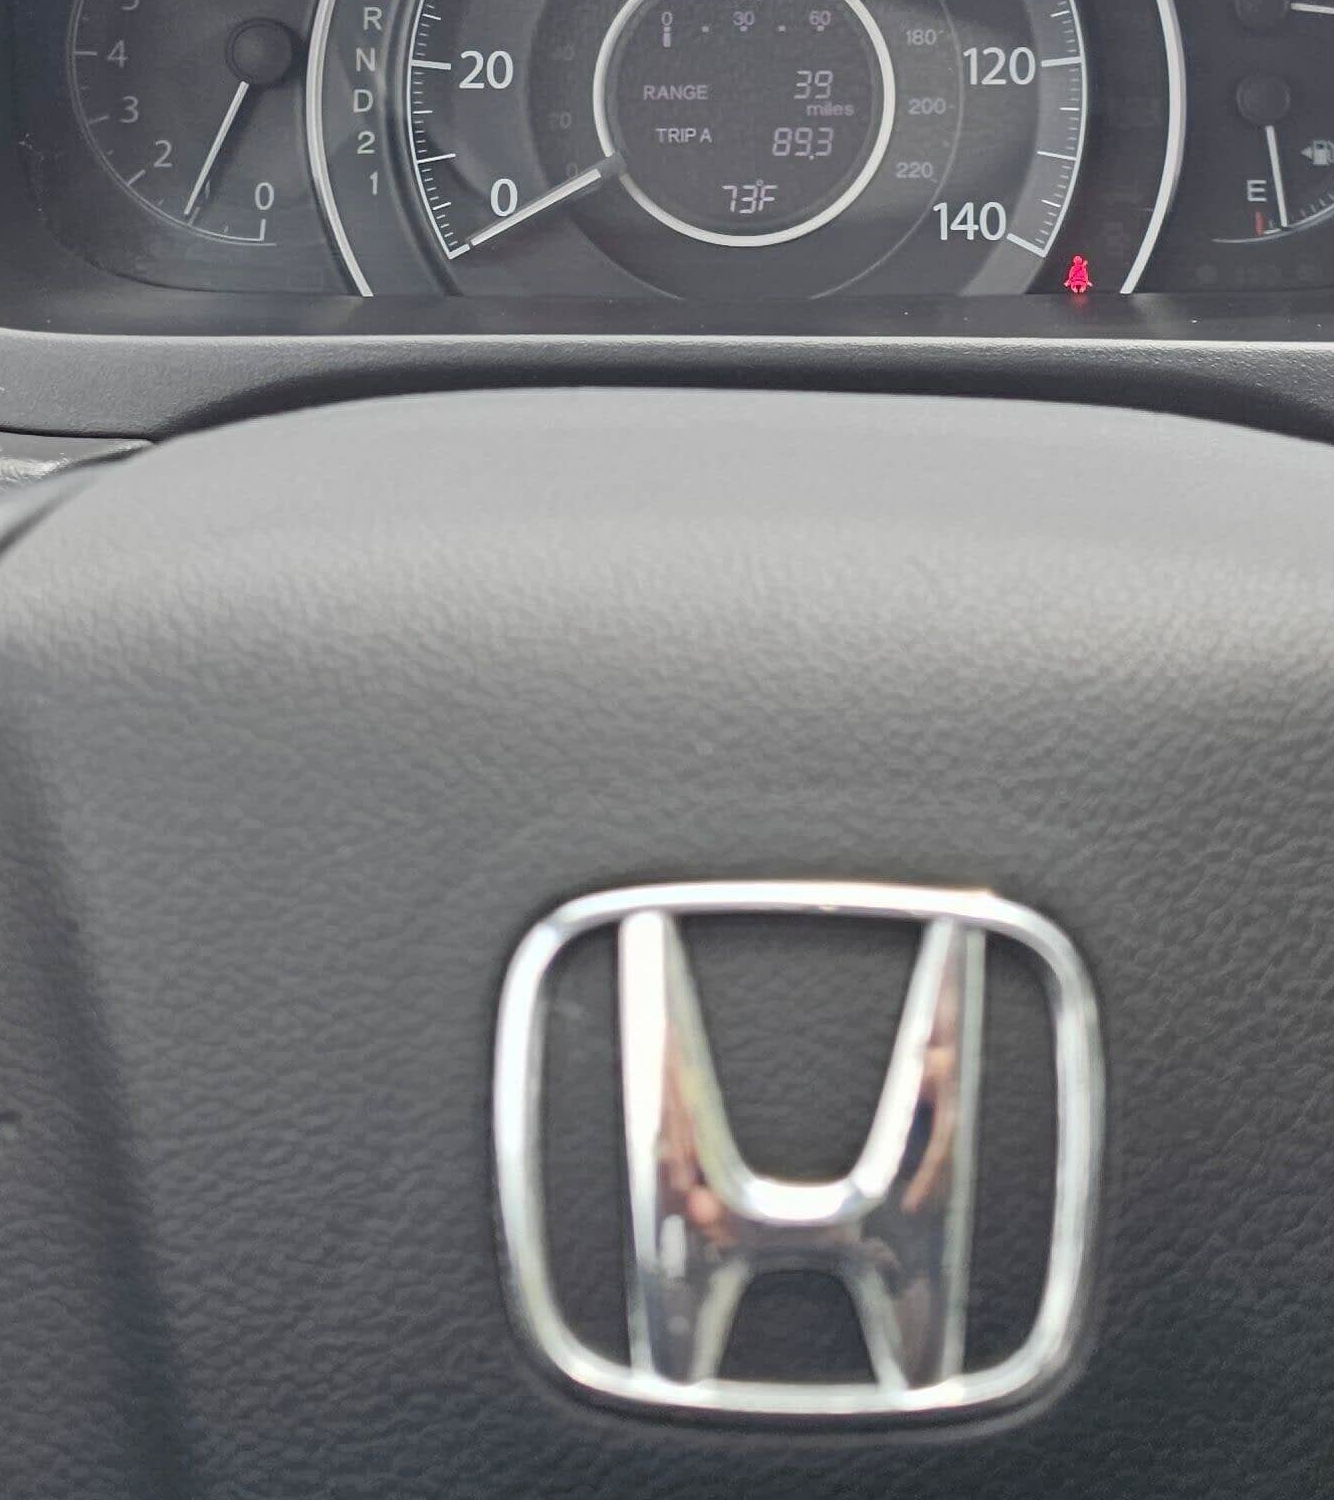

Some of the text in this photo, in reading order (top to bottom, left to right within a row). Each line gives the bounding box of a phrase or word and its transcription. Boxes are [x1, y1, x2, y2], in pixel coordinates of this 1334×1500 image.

[364, 7, 383, 31] R
[733, 11, 755, 26] 30
[808, 10, 832, 26] 60
[906, 28, 937, 46] 180
[106, 40, 128, 67] 4
[355, 48, 375, 72] N
[459, 50, 514, 89] 20
[963, 47, 1037, 86] 120
[643, 85, 709, 101] RANGE
[794, 70, 834, 100] 39
[119, 96, 140, 123] 3
[353, 90, 373, 113] D
[806, 102, 855, 117] miles
[908, 98, 946, 115] 200
[357, 131, 376, 154] 2
[655, 127, 713, 143] TRIP A
[153, 140, 173, 168] 2
[895, 162, 934, 179] 220
[369, 171, 379, 195] 1
[1247, 179, 1267, 202] E
[254, 182, 274, 211] 0
[490, 178, 518, 217] 0
[933, 201, 1006, 241] 140
